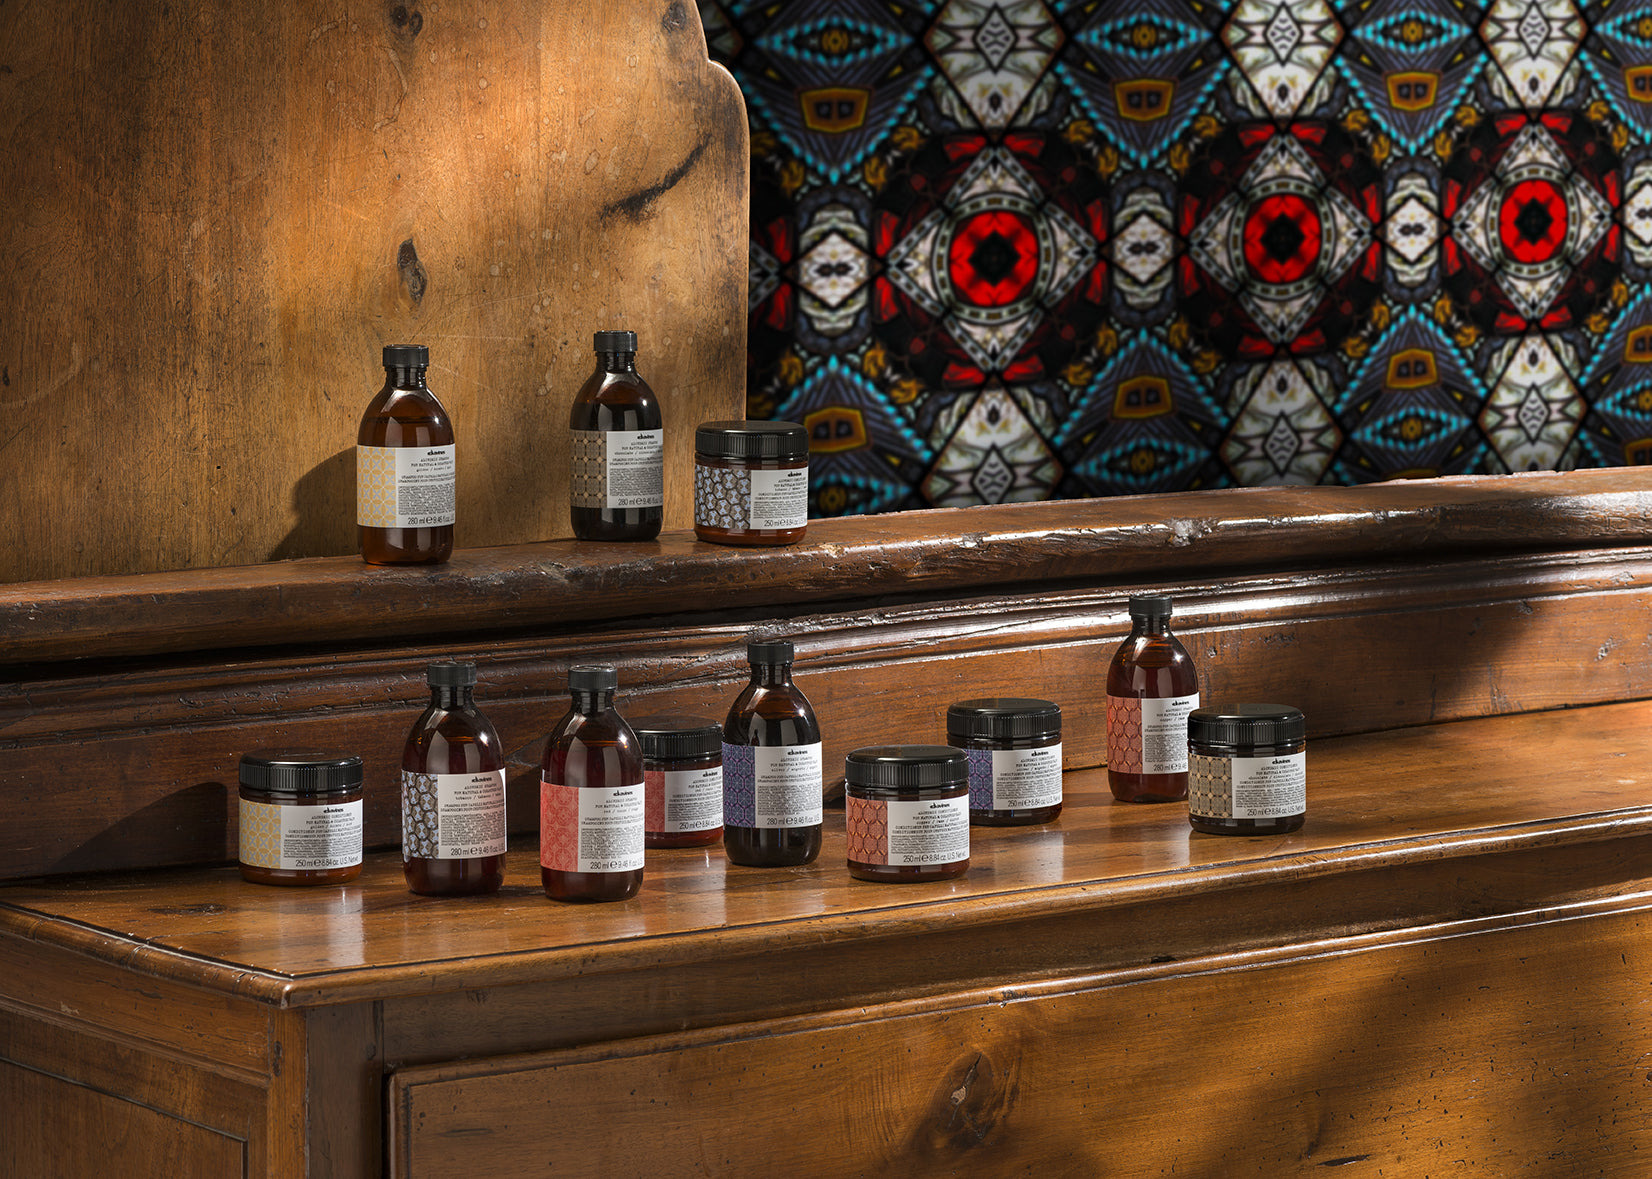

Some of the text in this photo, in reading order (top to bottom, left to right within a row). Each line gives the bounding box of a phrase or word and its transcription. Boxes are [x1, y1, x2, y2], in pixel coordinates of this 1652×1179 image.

[451, 848, 462, 856] 280
[904, 854, 913, 862] 250
[296, 859, 306, 867] 250
[590, 861, 602, 870] 280
